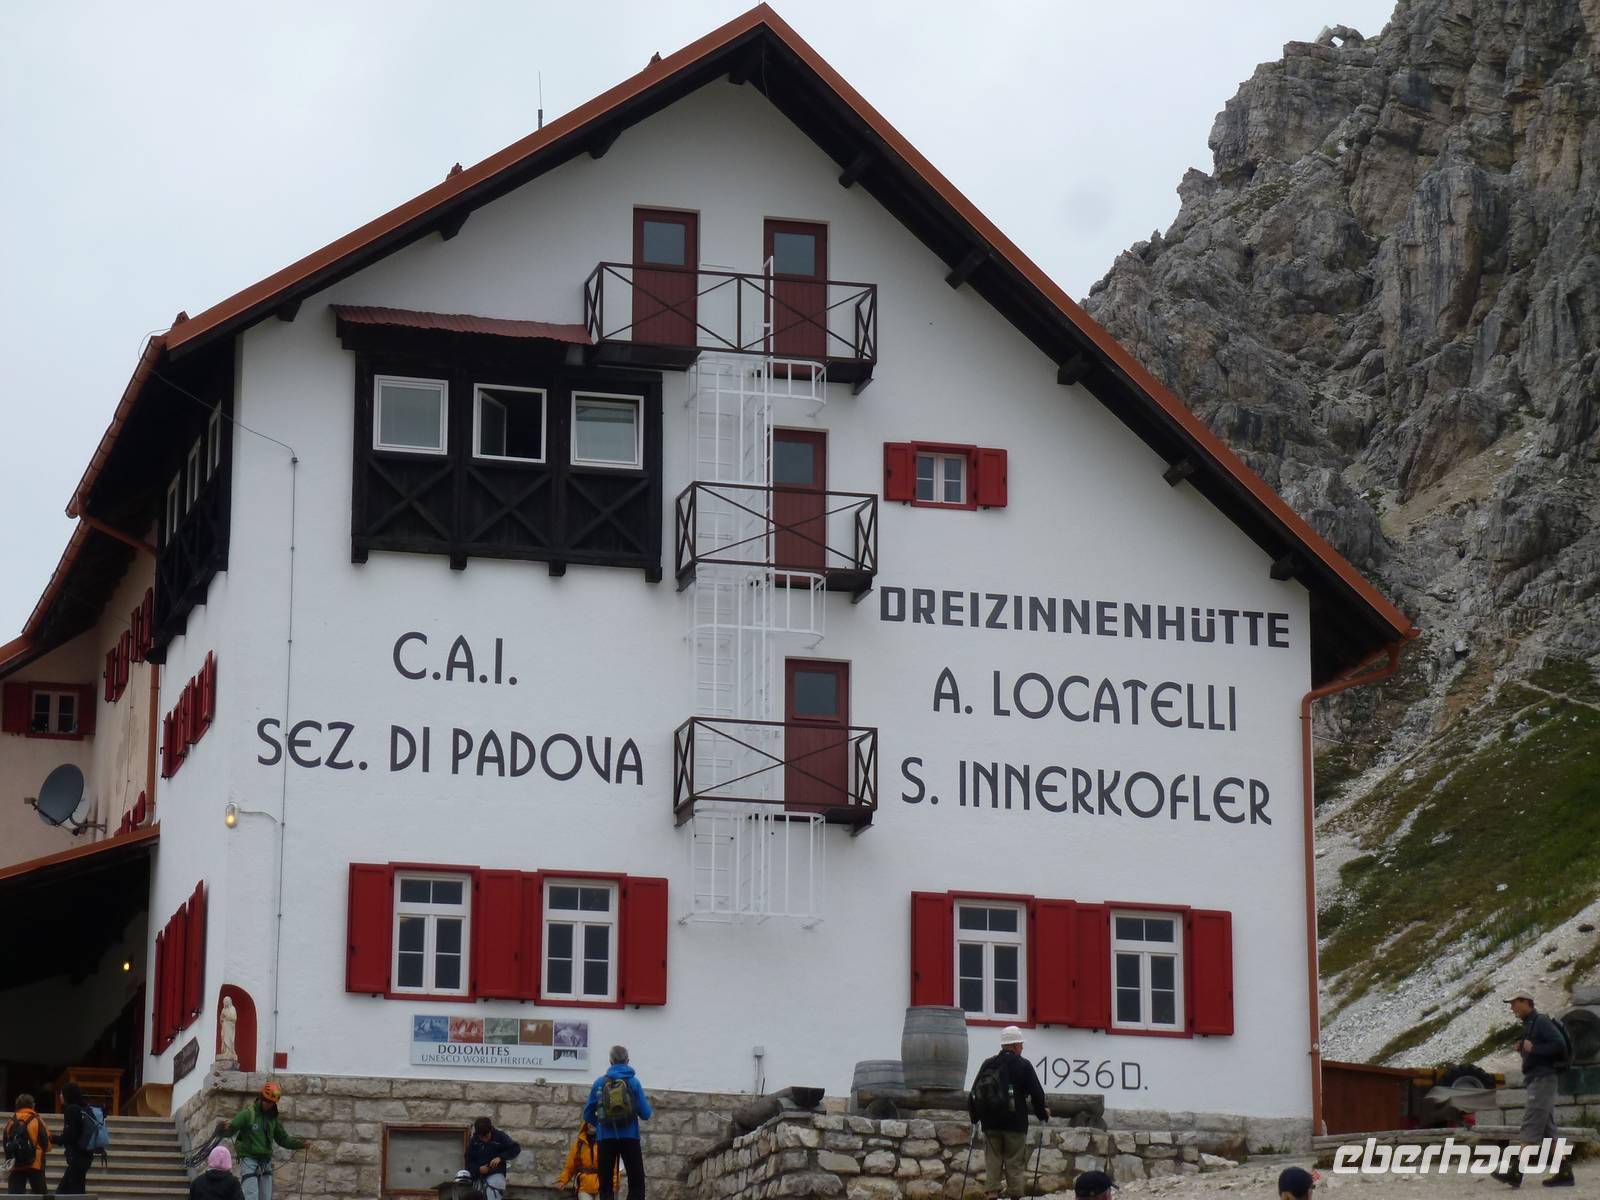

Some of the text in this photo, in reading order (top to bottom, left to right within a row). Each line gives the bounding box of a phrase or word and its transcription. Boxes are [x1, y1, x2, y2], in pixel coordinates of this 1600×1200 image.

[880, 586, 1290, 648] DREIZINNENHÜTTE
[392, 631, 518, 685] C.A.I.
[933, 666, 1237, 732] A. LOCATELLI
[256, 717, 644, 786] SEZ. DI PADOVA
[900, 756, 1272, 826] S. INNERKOFLER
[421, 1054, 543, 1066] UNESCO WORLD HERITAGE
[438, 1044, 510, 1056] DOLOMITES
